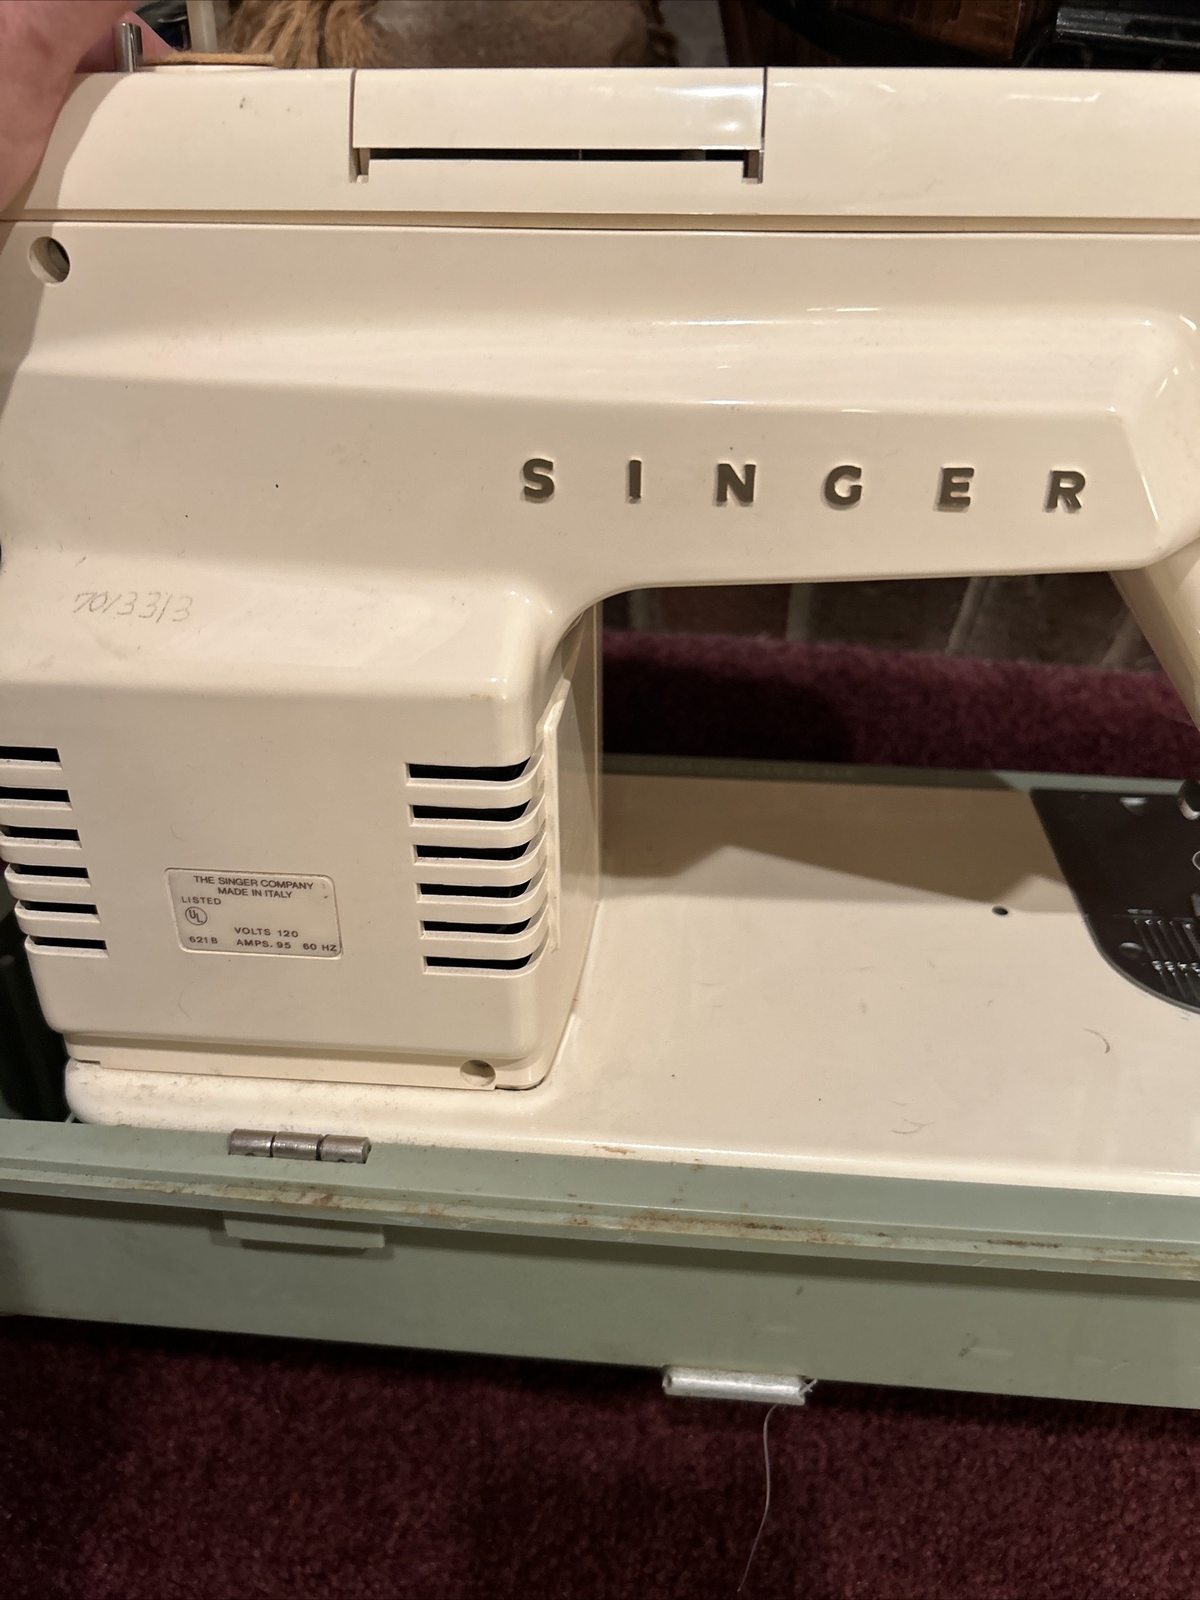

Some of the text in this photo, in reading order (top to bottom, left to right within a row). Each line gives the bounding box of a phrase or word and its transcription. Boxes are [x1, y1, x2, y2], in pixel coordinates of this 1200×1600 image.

[522, 457, 1087, 512] SINGER
[193, 875, 314, 890] THE SINGER COMPANY
[217, 887, 293, 899] MADE IN ITALY
[181, 896, 222, 905] LISTED
[234, 926, 299, 938] VOLTS 120
[302, 943, 317, 951] 60
[321, 944, 337, 952] HZ
